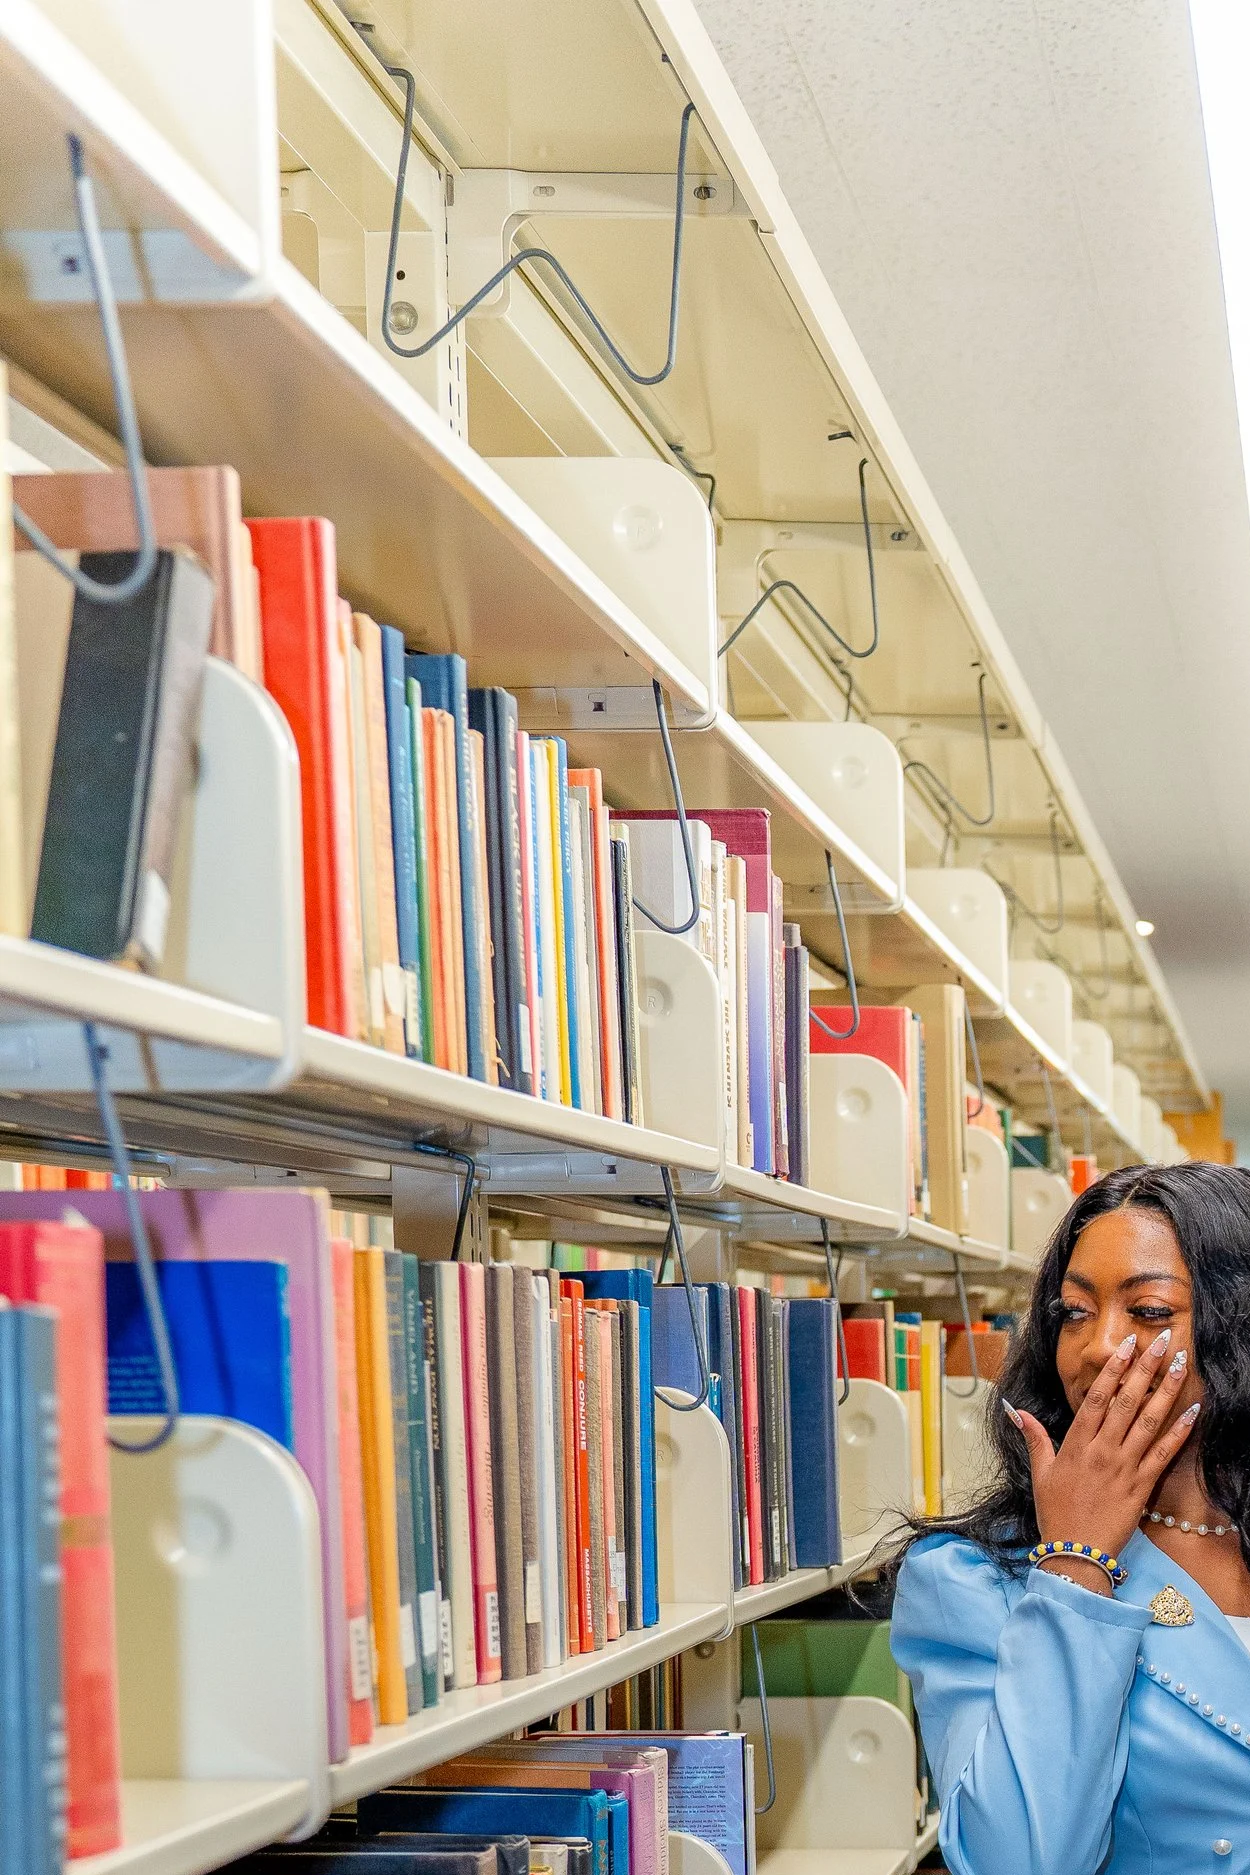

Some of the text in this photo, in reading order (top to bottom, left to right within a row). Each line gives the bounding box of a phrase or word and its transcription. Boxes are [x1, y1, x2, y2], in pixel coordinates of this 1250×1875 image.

[509, 767, 519, 861] BLACK
[407, 1289, 418, 1394] VINELAND
[424, 1297, 441, 1450] THOMAS PYNCHON
[578, 1379, 587, 1450] CONJURE
[584, 1548, 594, 1633] MASSACHUSETTS
[657, 1766, 666, 1814] Sidney
[659, 1818, 668, 1875] Sheldon
